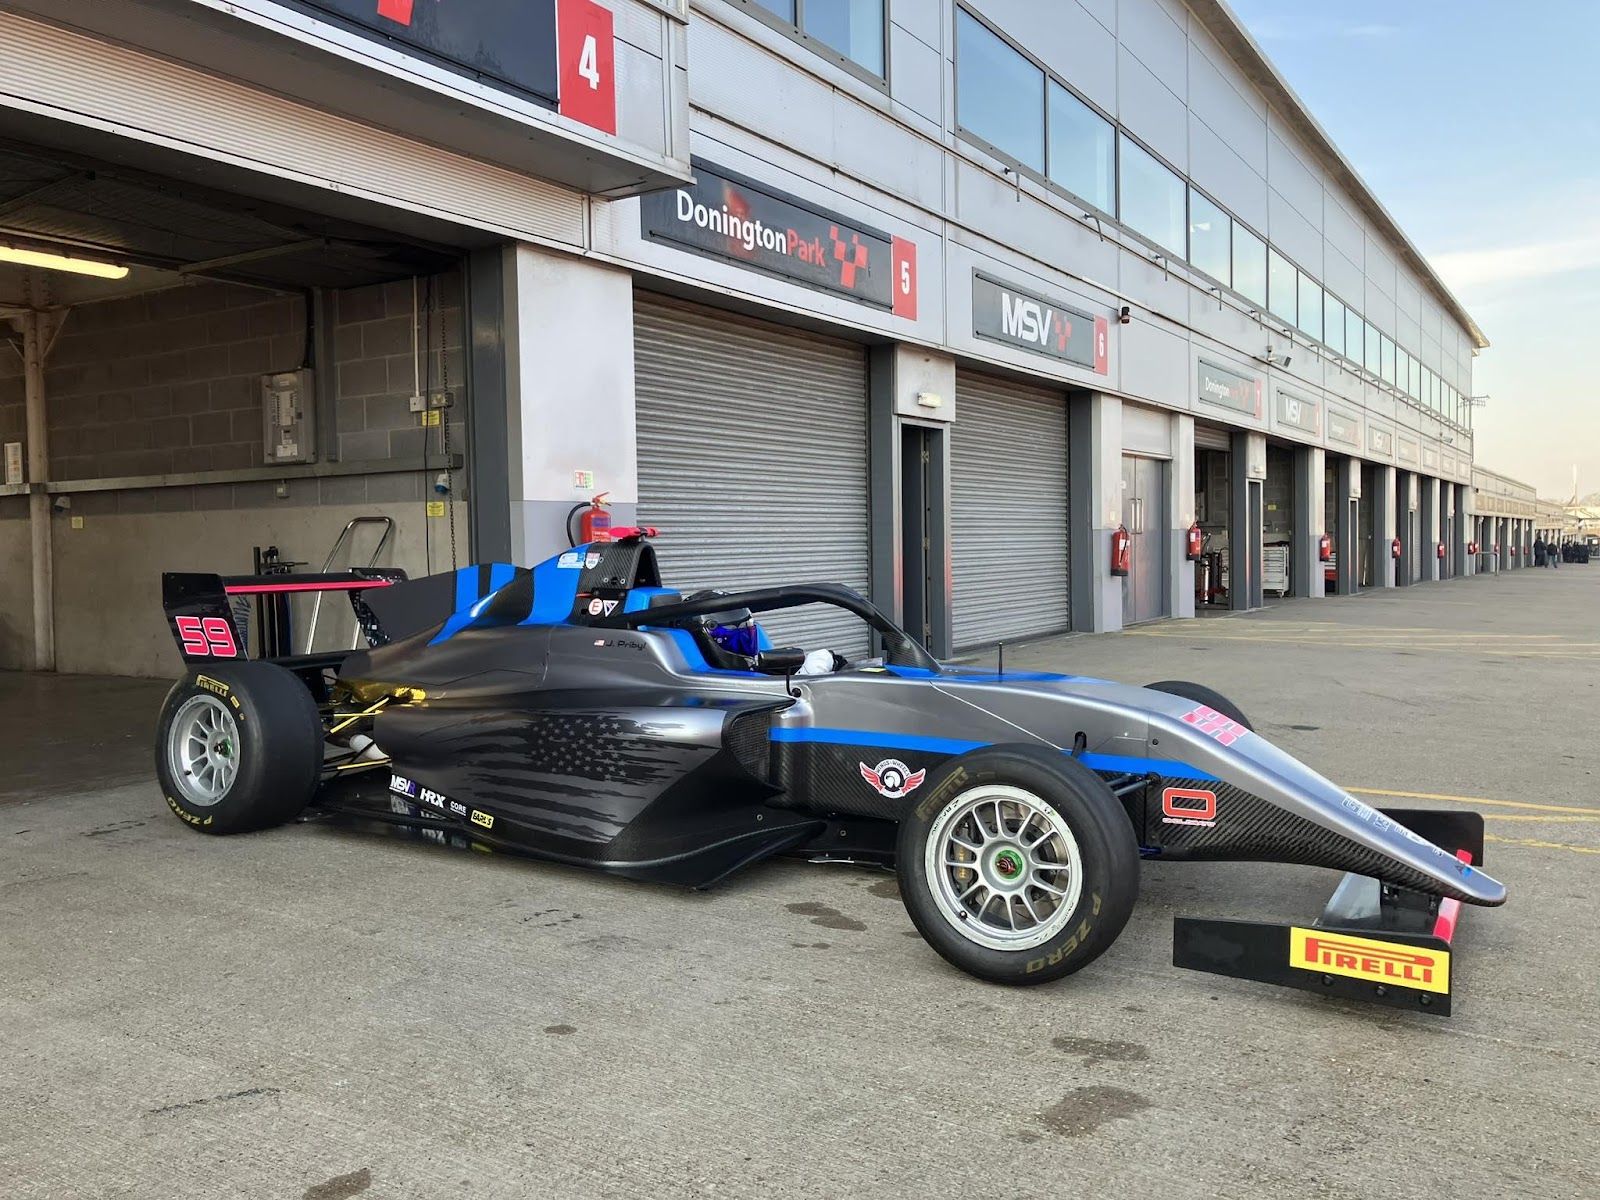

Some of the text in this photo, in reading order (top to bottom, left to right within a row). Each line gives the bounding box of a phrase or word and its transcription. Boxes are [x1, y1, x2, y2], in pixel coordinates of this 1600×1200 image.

[578, 34, 600, 91] 4
[900, 261, 911, 295] 5
[1002, 292, 1053, 346] MSV
[1098, 332, 1105, 358] 6
[175, 616, 238, 657] 59
[195, 674, 230, 697] PIRELLI
[420, 788, 446, 809] HRX
[1025, 917, 1092, 974] ZERO
[1304, 937, 1435, 983] PIRELLI
